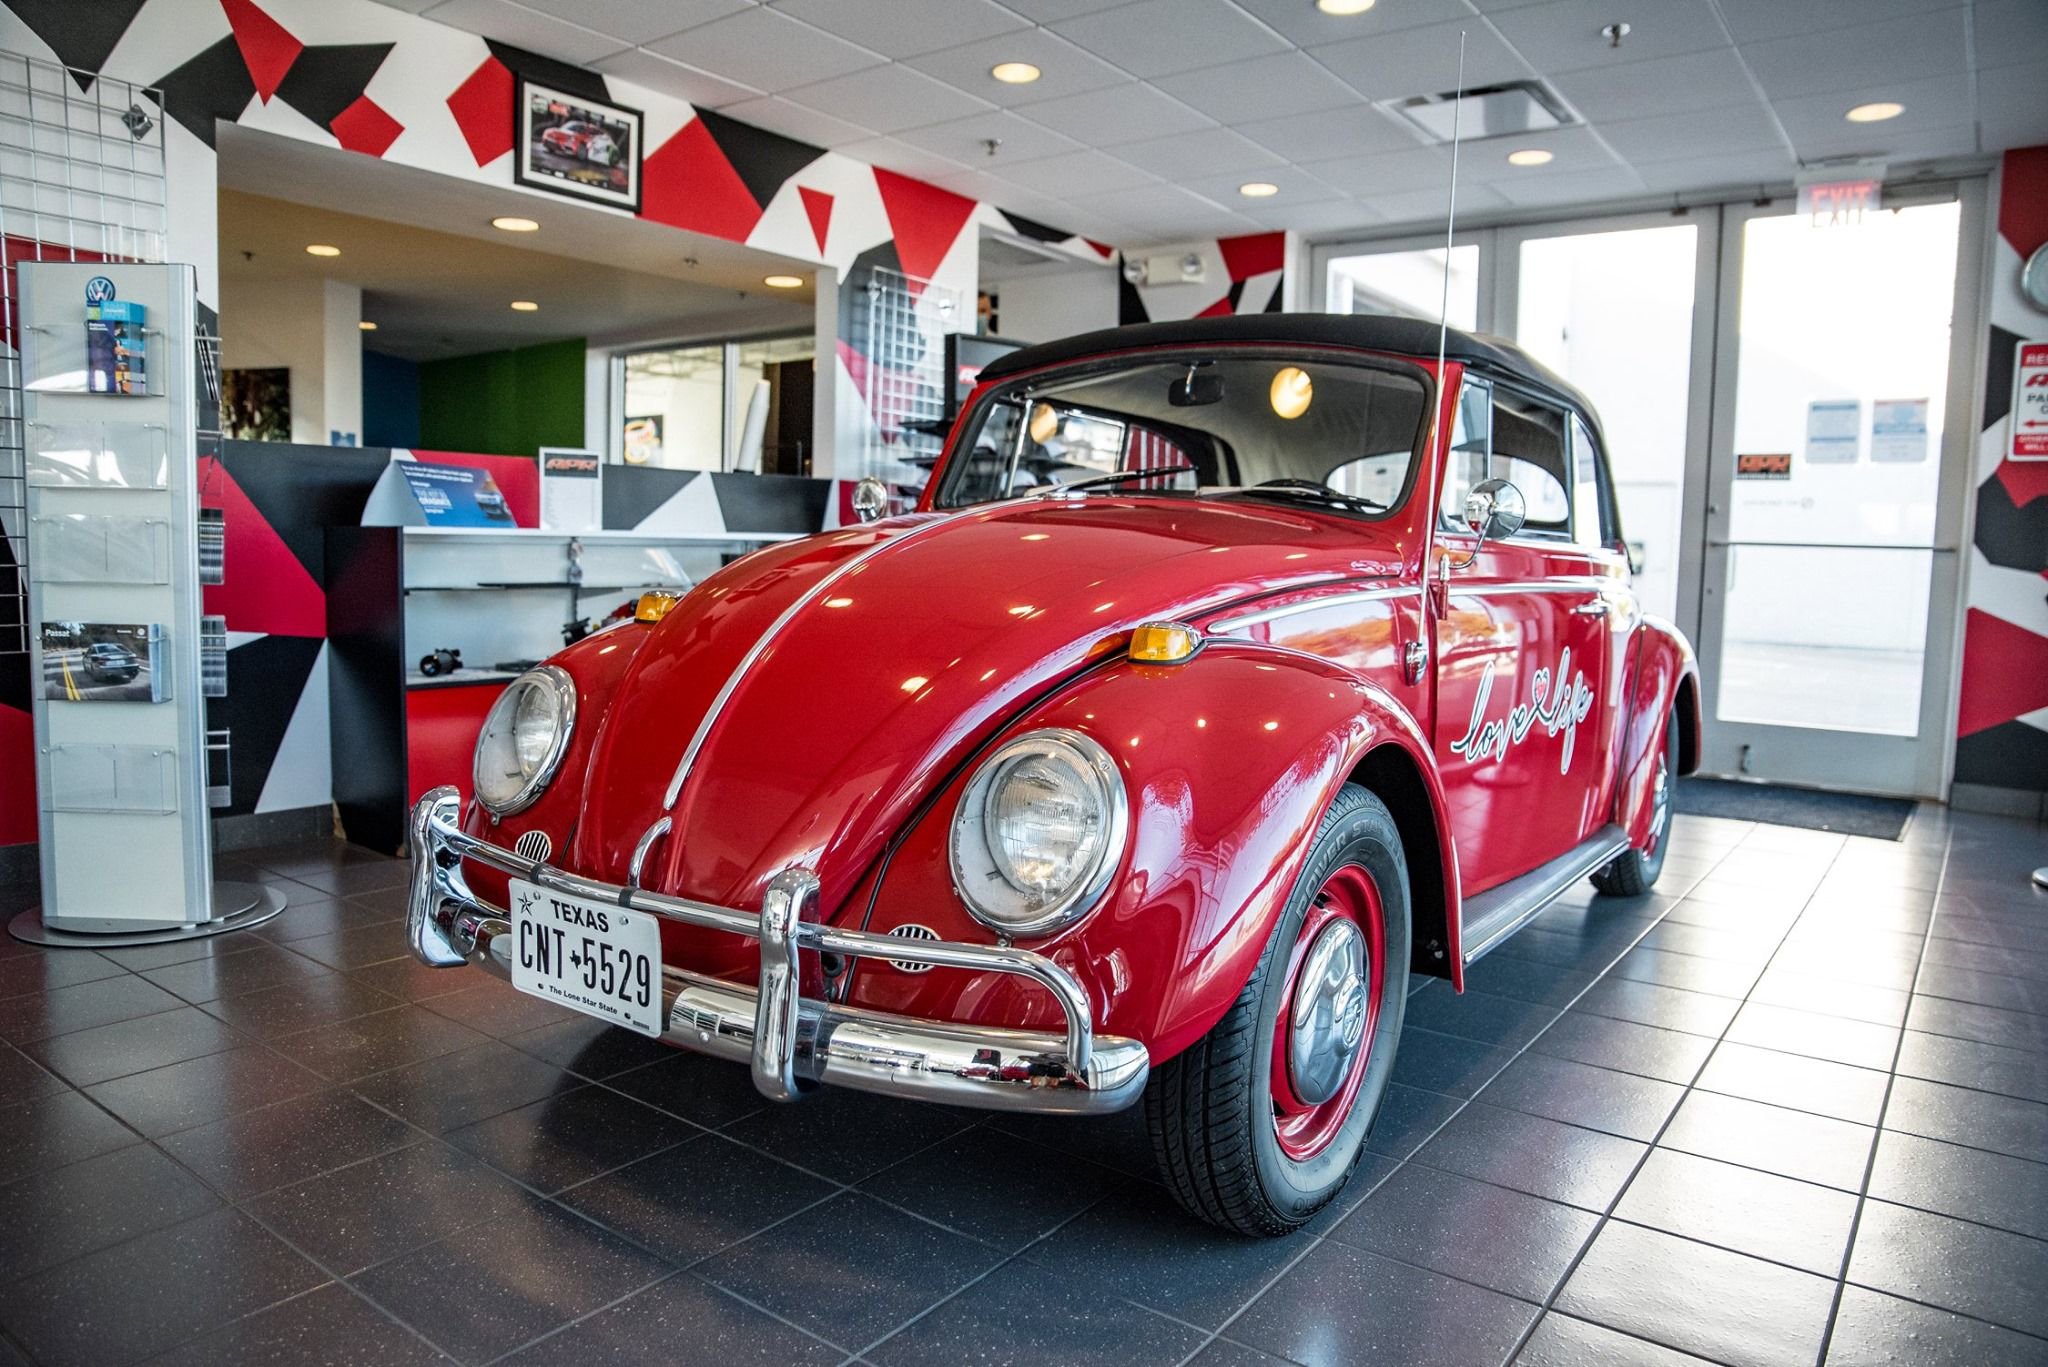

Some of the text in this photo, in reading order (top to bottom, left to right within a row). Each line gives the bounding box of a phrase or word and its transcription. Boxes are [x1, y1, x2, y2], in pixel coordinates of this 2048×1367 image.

[1811, 185, 1871, 227] EXIT
[45, 629, 70, 637] Passat
[1296, 831, 1347, 920] POWER
[550, 899, 609, 932] TEXAS
[520, 919, 650, 1008] CNT 5529
[549, 985, 618, 1015] The Lone Star State
